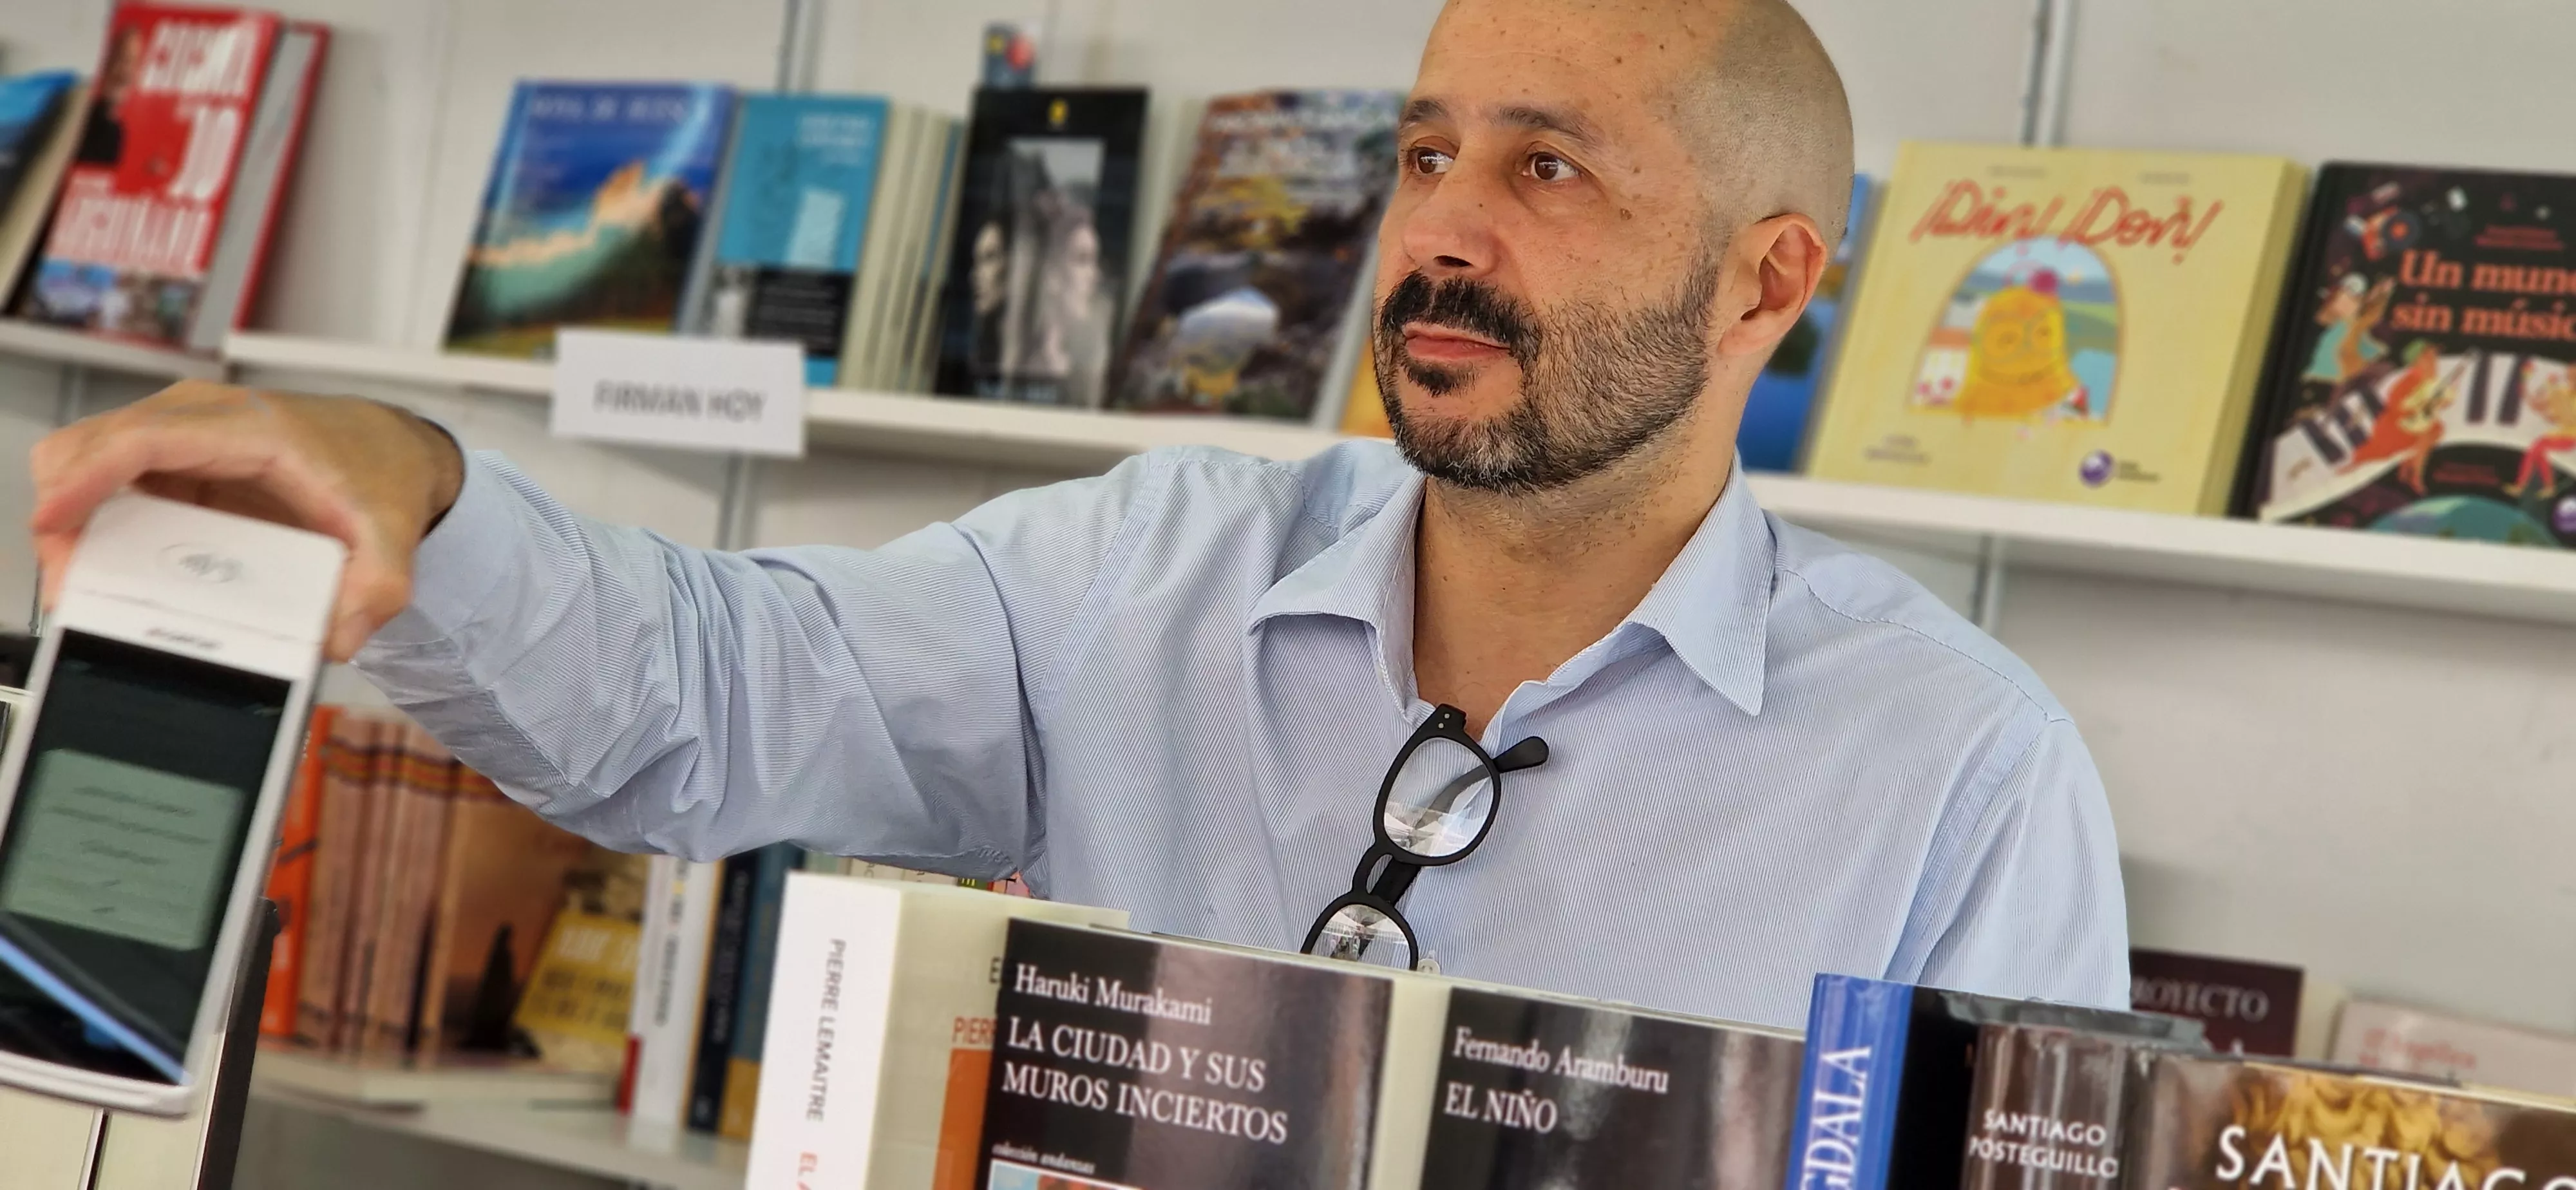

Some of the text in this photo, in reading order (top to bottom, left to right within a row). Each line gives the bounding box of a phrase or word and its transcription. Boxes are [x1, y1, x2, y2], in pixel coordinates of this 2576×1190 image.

[2400, 249, 2463, 288] Un
[2392, 292, 2452, 332] sin
[592, 380, 768, 424] FIRMAN HOY
[1014, 963, 1212, 1026] Haruki Murakami
[806, 938, 846, 1122] PIERRE LEMAITRE
[952, 1016, 997, 1045] PIER
[1007, 1016, 1266, 1093] LA CIUDAD Y SUS
[1451, 1026, 1671, 1095] Fernando Aramburu
[1002, 1061, 1288, 1144] MUROS INCIERTOS
[1443, 1082, 1558, 1135] EL NIÑO
[1983, 1108, 2107, 1147] SANTIAGO
[798, 1151, 818, 1176] EL
[1968, 1135, 2119, 1180] POSTEGUILLO
[2215, 1124, 2576, 1190] SANTIA
